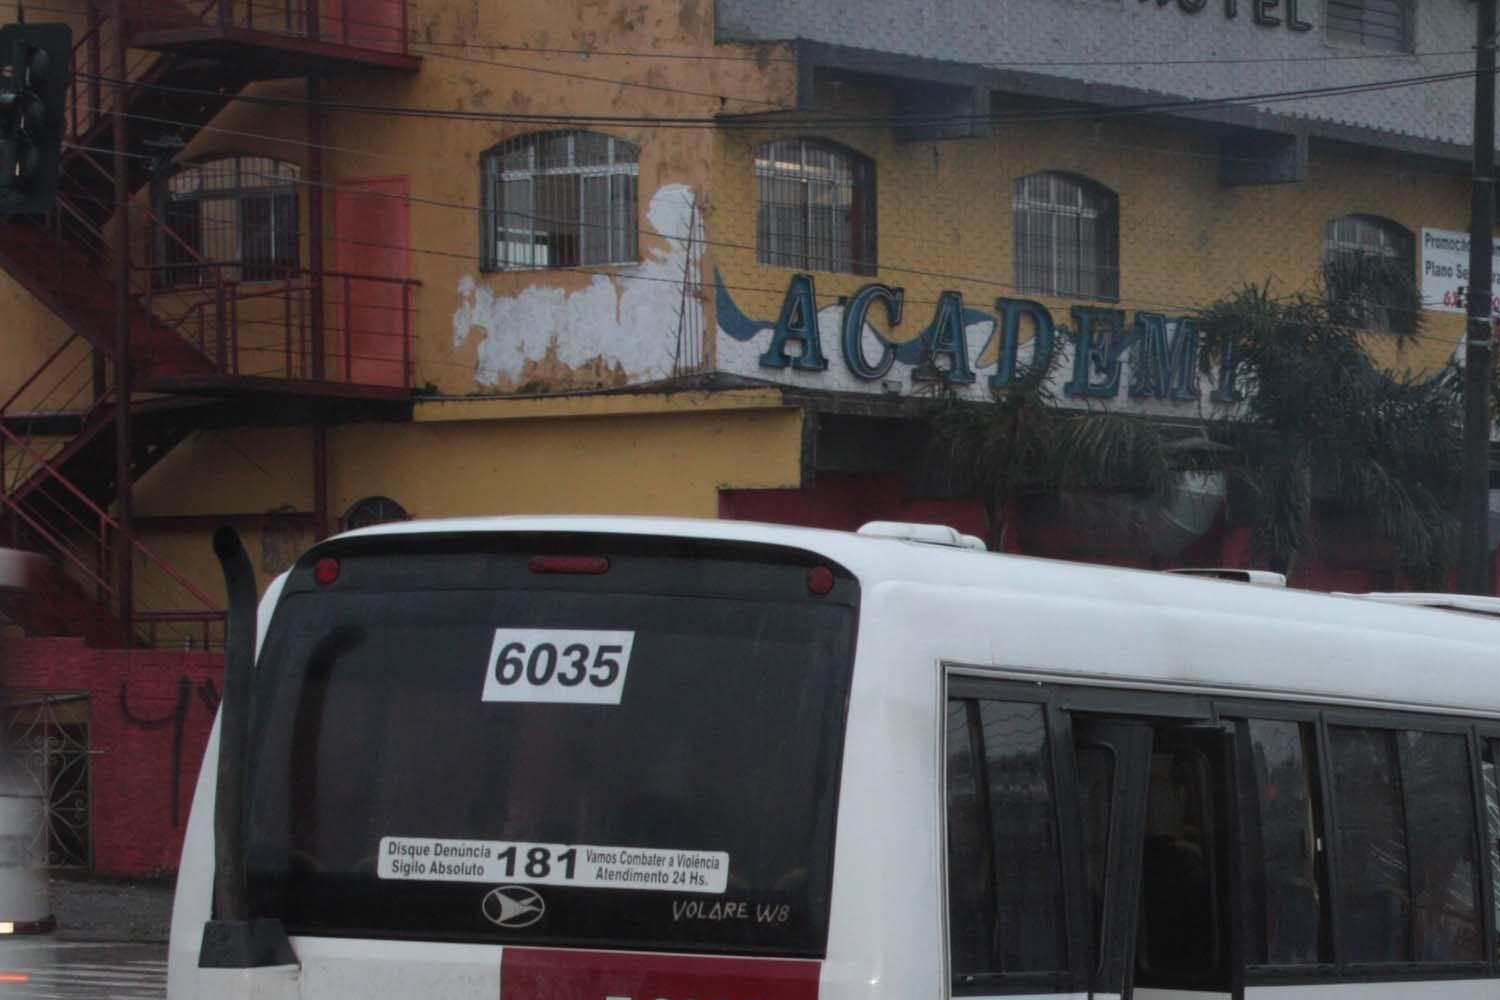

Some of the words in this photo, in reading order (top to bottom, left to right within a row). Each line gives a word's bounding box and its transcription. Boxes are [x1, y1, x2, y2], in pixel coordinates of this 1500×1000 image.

[1425, 260, 1453, 277] Plano
[494, 642, 623, 687] 6035
[388, 842, 430, 859] Disque
[433, 843, 491, 858] Denúncia
[497, 846, 577, 880] 181
[392, 859, 426, 877] Sigilo
[430, 862, 485, 876] Absoluto
[586, 849, 617, 865] Vamos
[620, 850, 667, 868] Combater
[668, 858, 674, 868] a
[676, 852, 720, 869] Violência
[595, 867, 669, 885] Atendimento
[672, 871, 686, 885] 24
[688, 873, 708, 887] Hs.
[672, 900, 749, 921] VOLARE
[755, 903, 791, 923] W8
